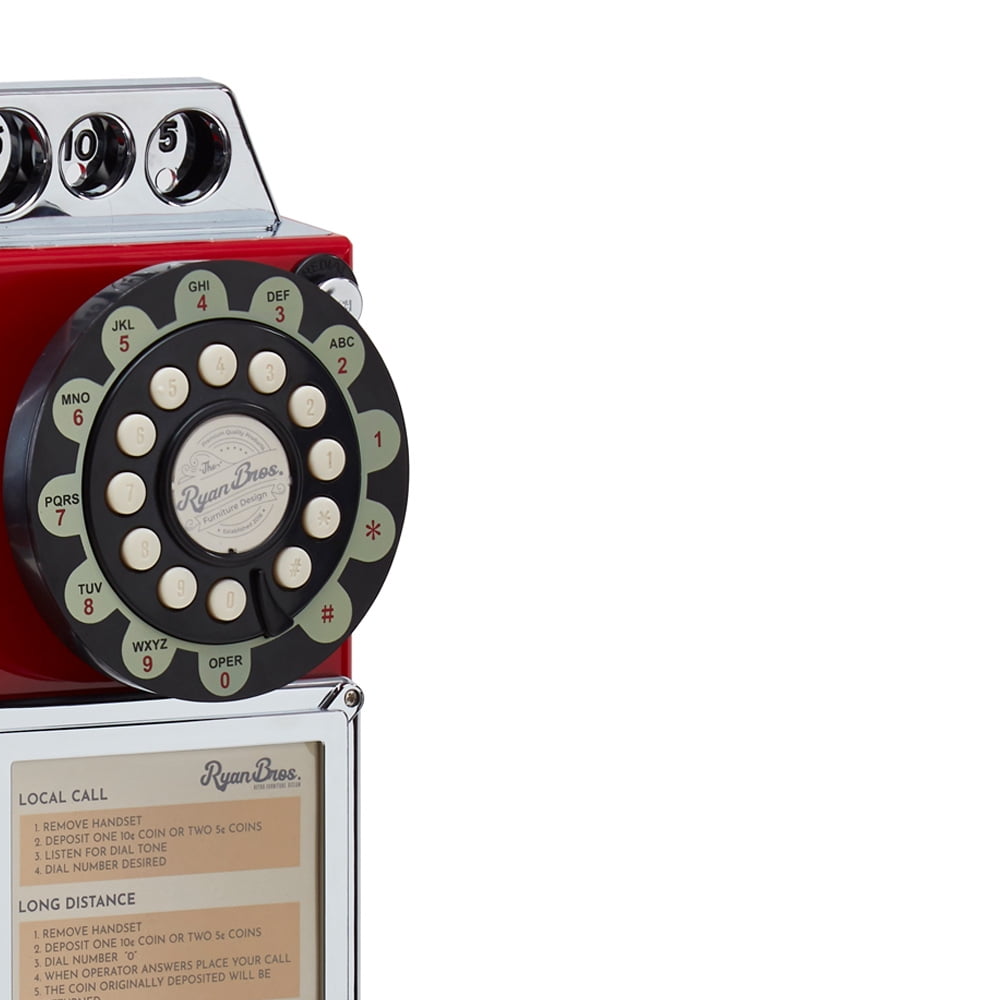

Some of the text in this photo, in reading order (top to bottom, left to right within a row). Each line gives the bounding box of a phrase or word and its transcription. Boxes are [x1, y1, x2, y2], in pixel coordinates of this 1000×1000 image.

[158, 120, 178, 152] 5
[64, 129, 98, 161] 10
[188, 280, 210, 292] GHI
[197, 294, 207, 311] 4
[267, 290, 290, 302] DEF
[275, 305, 285, 323] 3
[112, 319, 135, 332] JKL
[120, 335, 130, 352] 5
[329, 336, 355, 349] ABC
[337, 357, 348, 374] 2
[61, 392, 90, 406] MNO
[73, 408, 84, 426] 6
[373, 430, 381, 448] 1
[177, 461, 284, 513] Ryan Bros.
[44, 493, 80, 508] PQRS
[203, 504, 239, 524] Furniture
[240, 491, 268, 506] Design
[55, 509, 66, 526] 7
[78, 582, 103, 595] TUV
[84, 598, 94, 615] 8
[321, 604, 334, 623] #
[132, 638, 168, 653] WXYZ
[142, 655, 153, 673] 9
[209, 655, 243, 669] OPER
[220, 672, 230, 689] 0
[200, 757, 301, 792] Ryan Bros.
[19, 788, 108, 806] LOCAL CALL
[43, 819, 88, 832] REMOVE
[92, 816, 142, 828] HANDSET
[45, 833, 90, 846] DEPOSIT
[93, 832, 117, 843] ONE
[138, 828, 166, 840] COIN
[169, 827, 184, 838] OR
[188, 825, 212, 836] TWO
[228, 822, 263, 833] COINS
[45, 848, 82, 860] LISTEN
[85, 847, 107, 857] FOR
[110, 845, 134, 856] DIAL
[138, 842, 168, 853] TONE
[45, 863, 70, 874] DIAL
[73, 860, 118, 872] NUMBER
[122, 856, 167, 869] DESIRED
[19, 892, 136, 913] LONG DISTANCE
[42, 926, 88, 938] REMOVE
[92, 922, 142, 935] HANDSET
[45, 940, 90, 952] DEPOSIT
[93, 938, 117, 949] ONE
[138, 935, 166, 946] COIN
[169, 933, 184, 944] OR
[188, 931, 212, 942] TWO
[228, 927, 262, 939] COINS
[45, 954, 68, 967] DIAL
[72, 952, 118, 965] NUMBER
[45, 969, 78, 981] WHEN
[82, 965, 138, 978] OPERATOR
[142, 960, 192, 974] ANSWERS
[196, 958, 228, 970] PLACE
[232, 955, 262, 966] YOUR
[265, 954, 292, 964] CALL
[45, 984, 65, 995] THE
[69, 982, 96, 994] COIN
[100, 977, 164, 992] ORIGINALLY
[168, 972, 226, 986] DEPOSITED
[230, 970, 254, 981] WILL
[258, 969, 271, 979] BE
